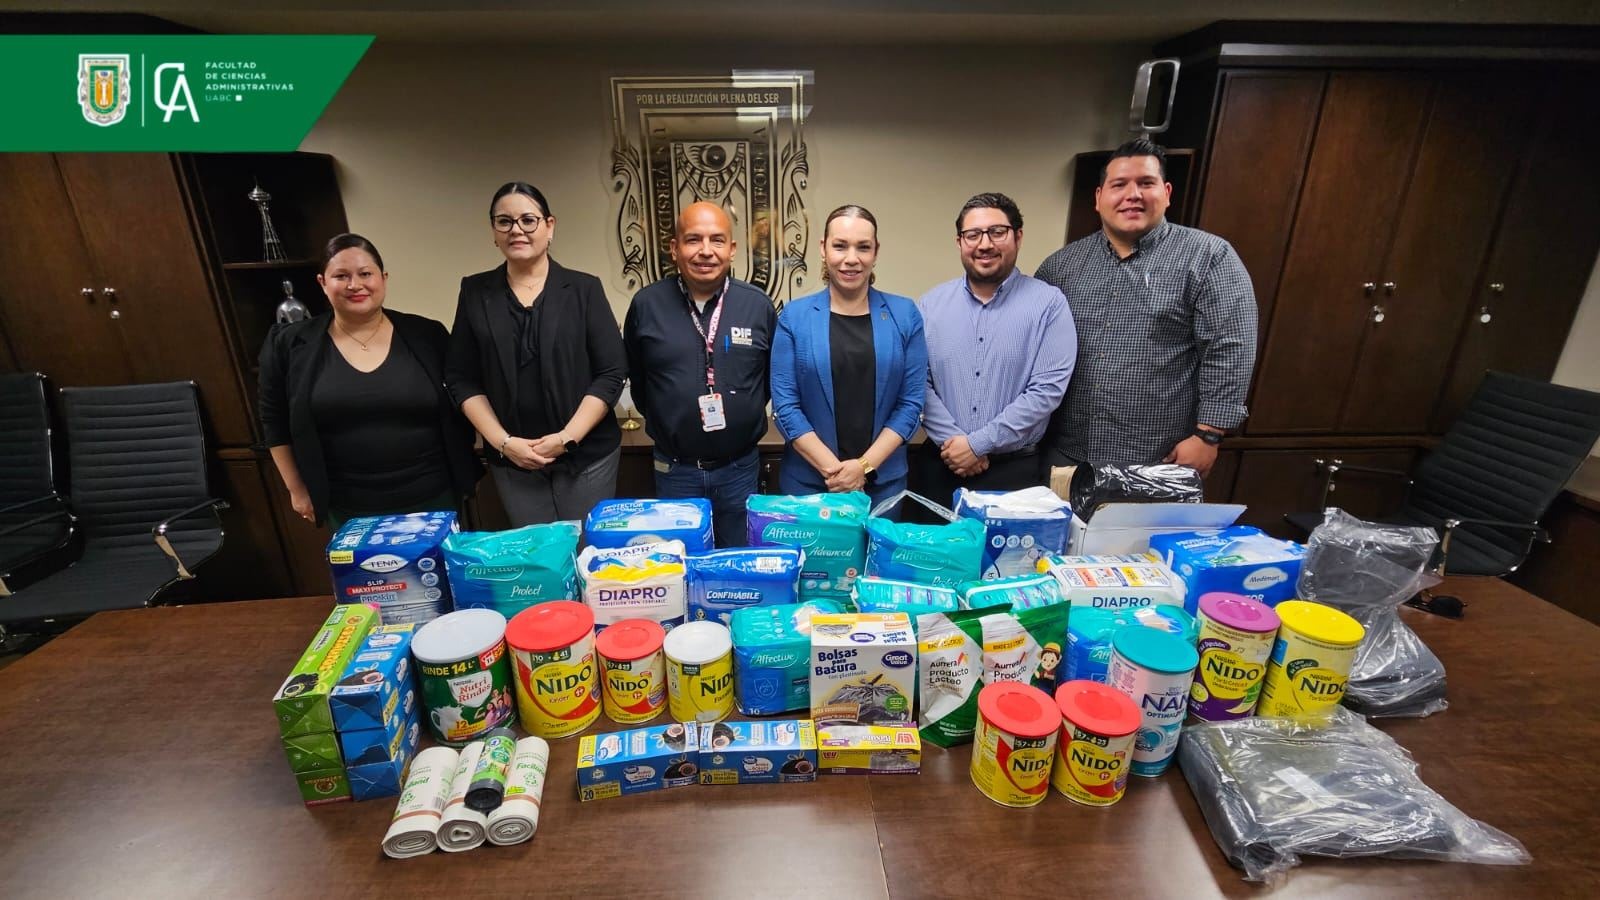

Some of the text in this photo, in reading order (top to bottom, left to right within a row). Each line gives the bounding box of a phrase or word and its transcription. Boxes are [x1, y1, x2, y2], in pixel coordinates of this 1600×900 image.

[637, 92, 780, 105] POR LA REALIZACIÓN PLENA DEL SER
[731, 326, 752, 338] DIF
[766, 526, 815, 539] Affective
[809, 546, 854, 558] Advanced
[370, 559, 399, 568] TENA
[371, 584, 404, 592] PROTECT
[510, 584, 542, 598] Protect
[599, 586, 667, 602] DIAPRO
[1092, 597, 1151, 608] DIAPRO
[755, 653, 795, 665] Affective
[817, 648, 858, 662] Bolsas
[422, 665, 449, 676] RINDE
[451, 662, 467, 675] 14
[815, 663, 857, 676] Basura
[832, 659, 847, 668] para
[1206, 657, 1260, 681] NIDO
[459, 676, 487, 694] Nutri
[536, 664, 592, 695] NIDO
[609, 678, 649, 692] NIDO
[929, 676, 962, 686] Lácteo
[458, 683, 491, 702] Rindes
[1141, 693, 1189, 711] NAN
[456, 720, 468, 730] 12
[1071, 750, 1121, 770] NIDO
[702, 774, 713, 784] 20
[584, 789, 594, 800] 20
